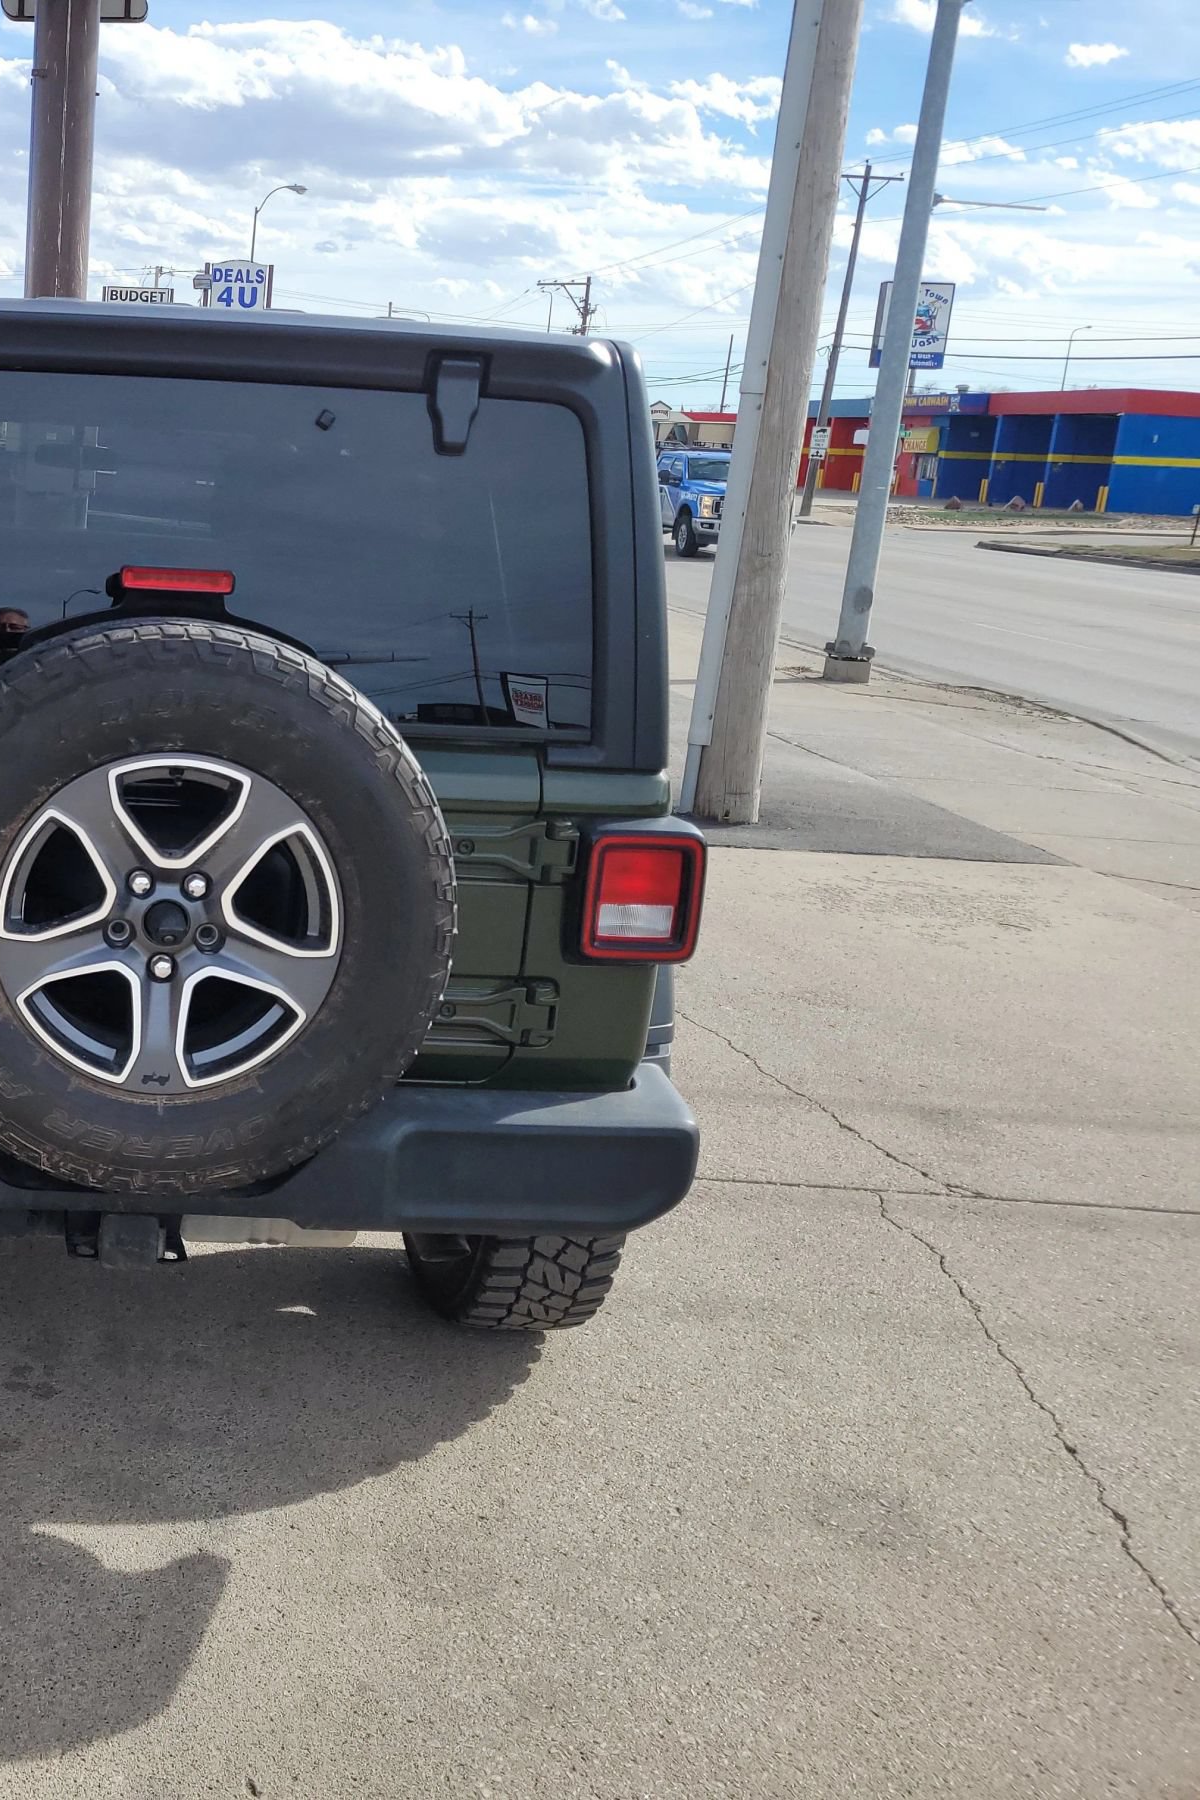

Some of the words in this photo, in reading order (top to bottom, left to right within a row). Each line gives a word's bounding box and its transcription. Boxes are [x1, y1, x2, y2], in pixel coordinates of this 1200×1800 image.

[212, 267, 265, 284] DEALS
[109, 289, 166, 304] BUDGET
[925, 289, 949, 305] Town
[918, 396, 949, 407] CARWASH
[903, 439, 928, 451] CHANGE
